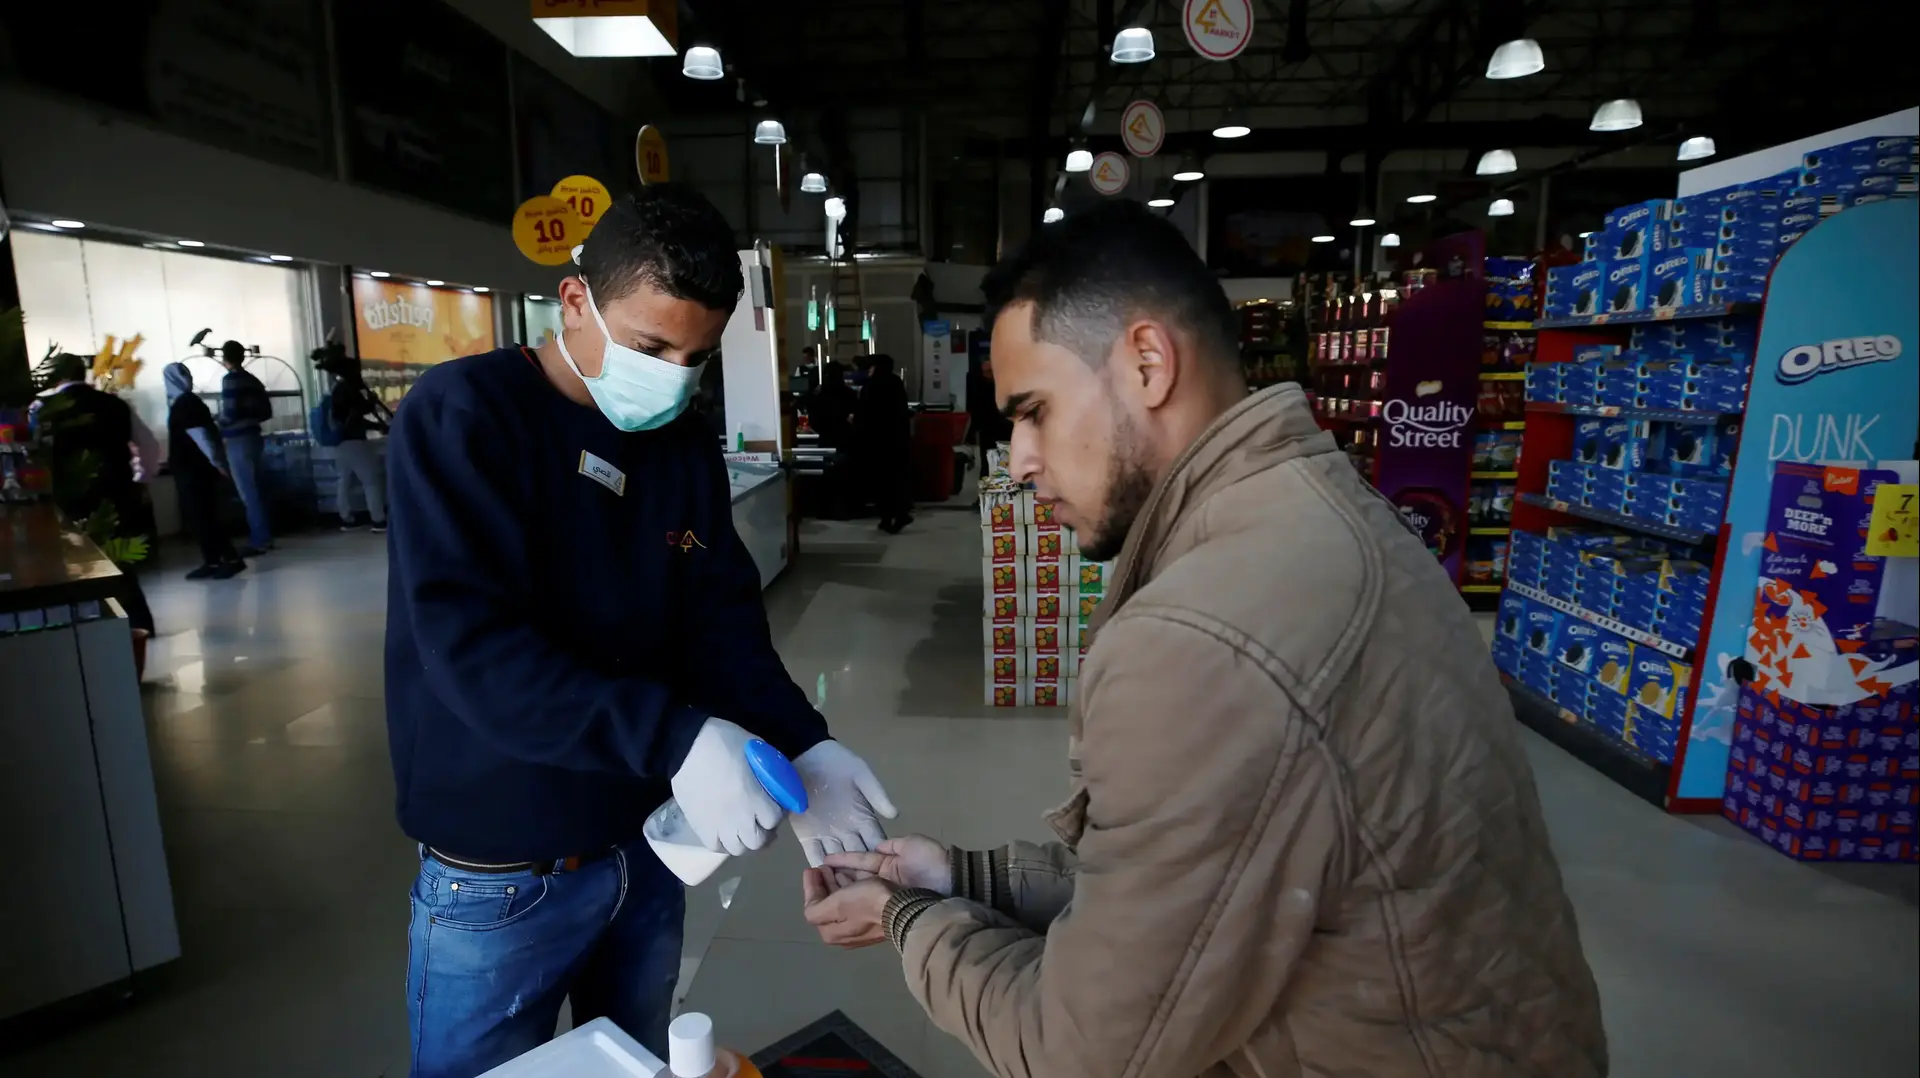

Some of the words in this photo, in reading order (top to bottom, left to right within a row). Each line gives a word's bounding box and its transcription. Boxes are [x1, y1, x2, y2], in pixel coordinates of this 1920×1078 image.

[646, 151, 660, 174] 10
[567, 196, 594, 217] 10
[534, 218, 565, 243] 10
[1776, 334, 1903, 384] OREO
[1383, 399, 1475, 431] Quality
[1389, 424, 1462, 448] Street
[1768, 413, 1881, 462] DUNK
[1786, 518, 1828, 536] MORE
